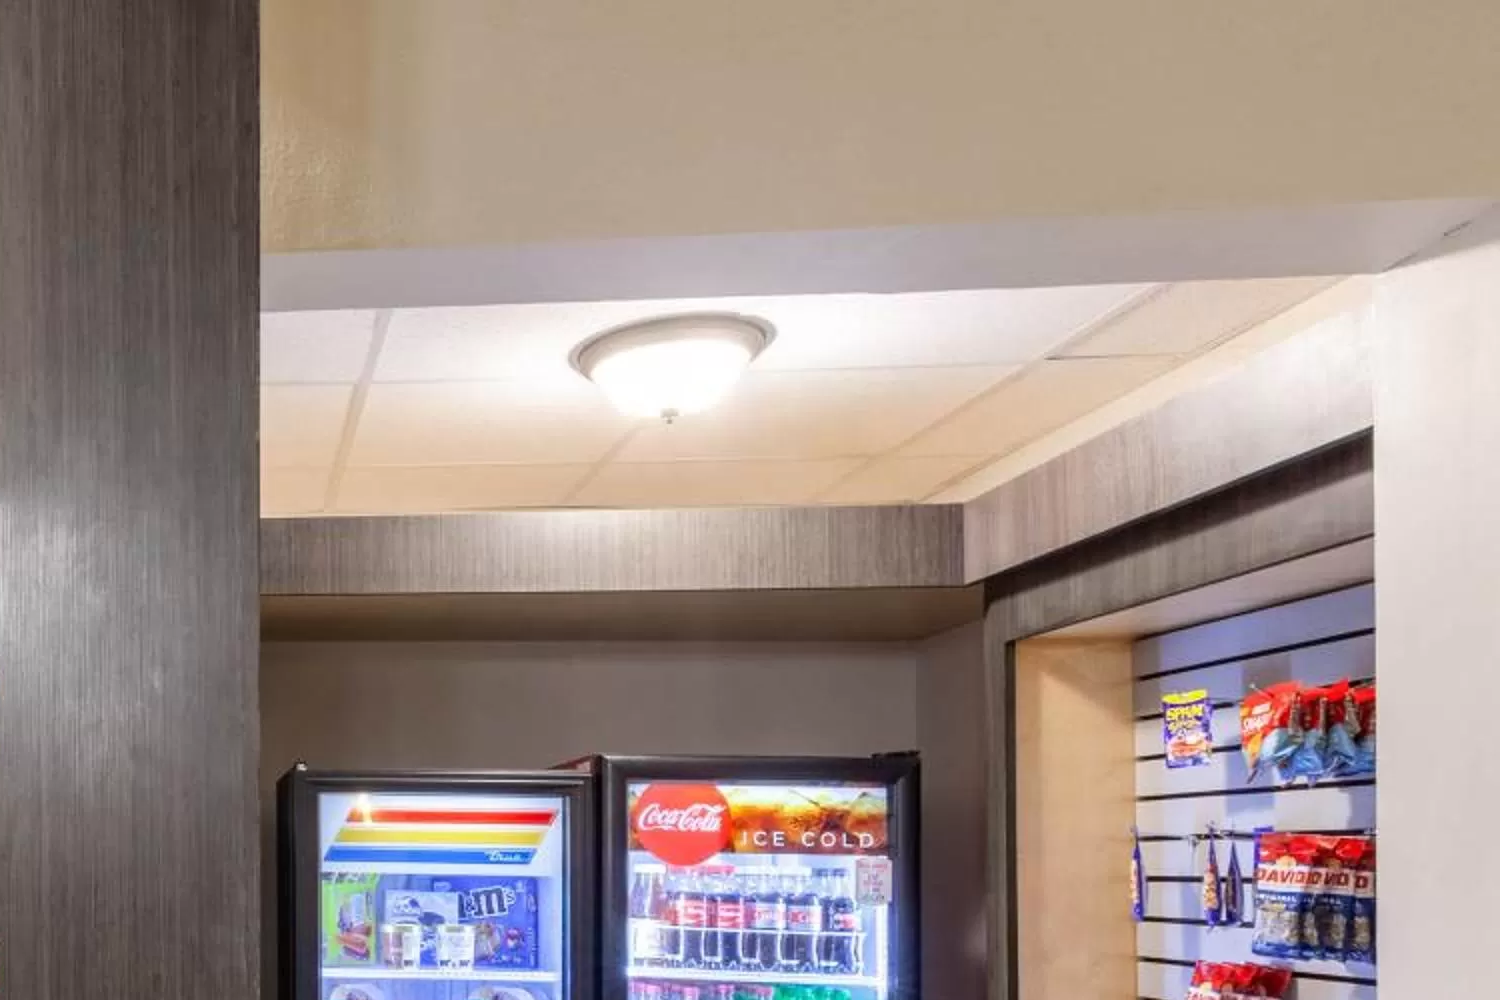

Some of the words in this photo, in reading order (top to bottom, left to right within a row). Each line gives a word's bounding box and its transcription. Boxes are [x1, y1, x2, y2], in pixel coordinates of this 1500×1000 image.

[638, 803, 727, 832] Coca-Cola
[740, 831, 785, 847] ICE
[801, 832, 875, 848] COLD
